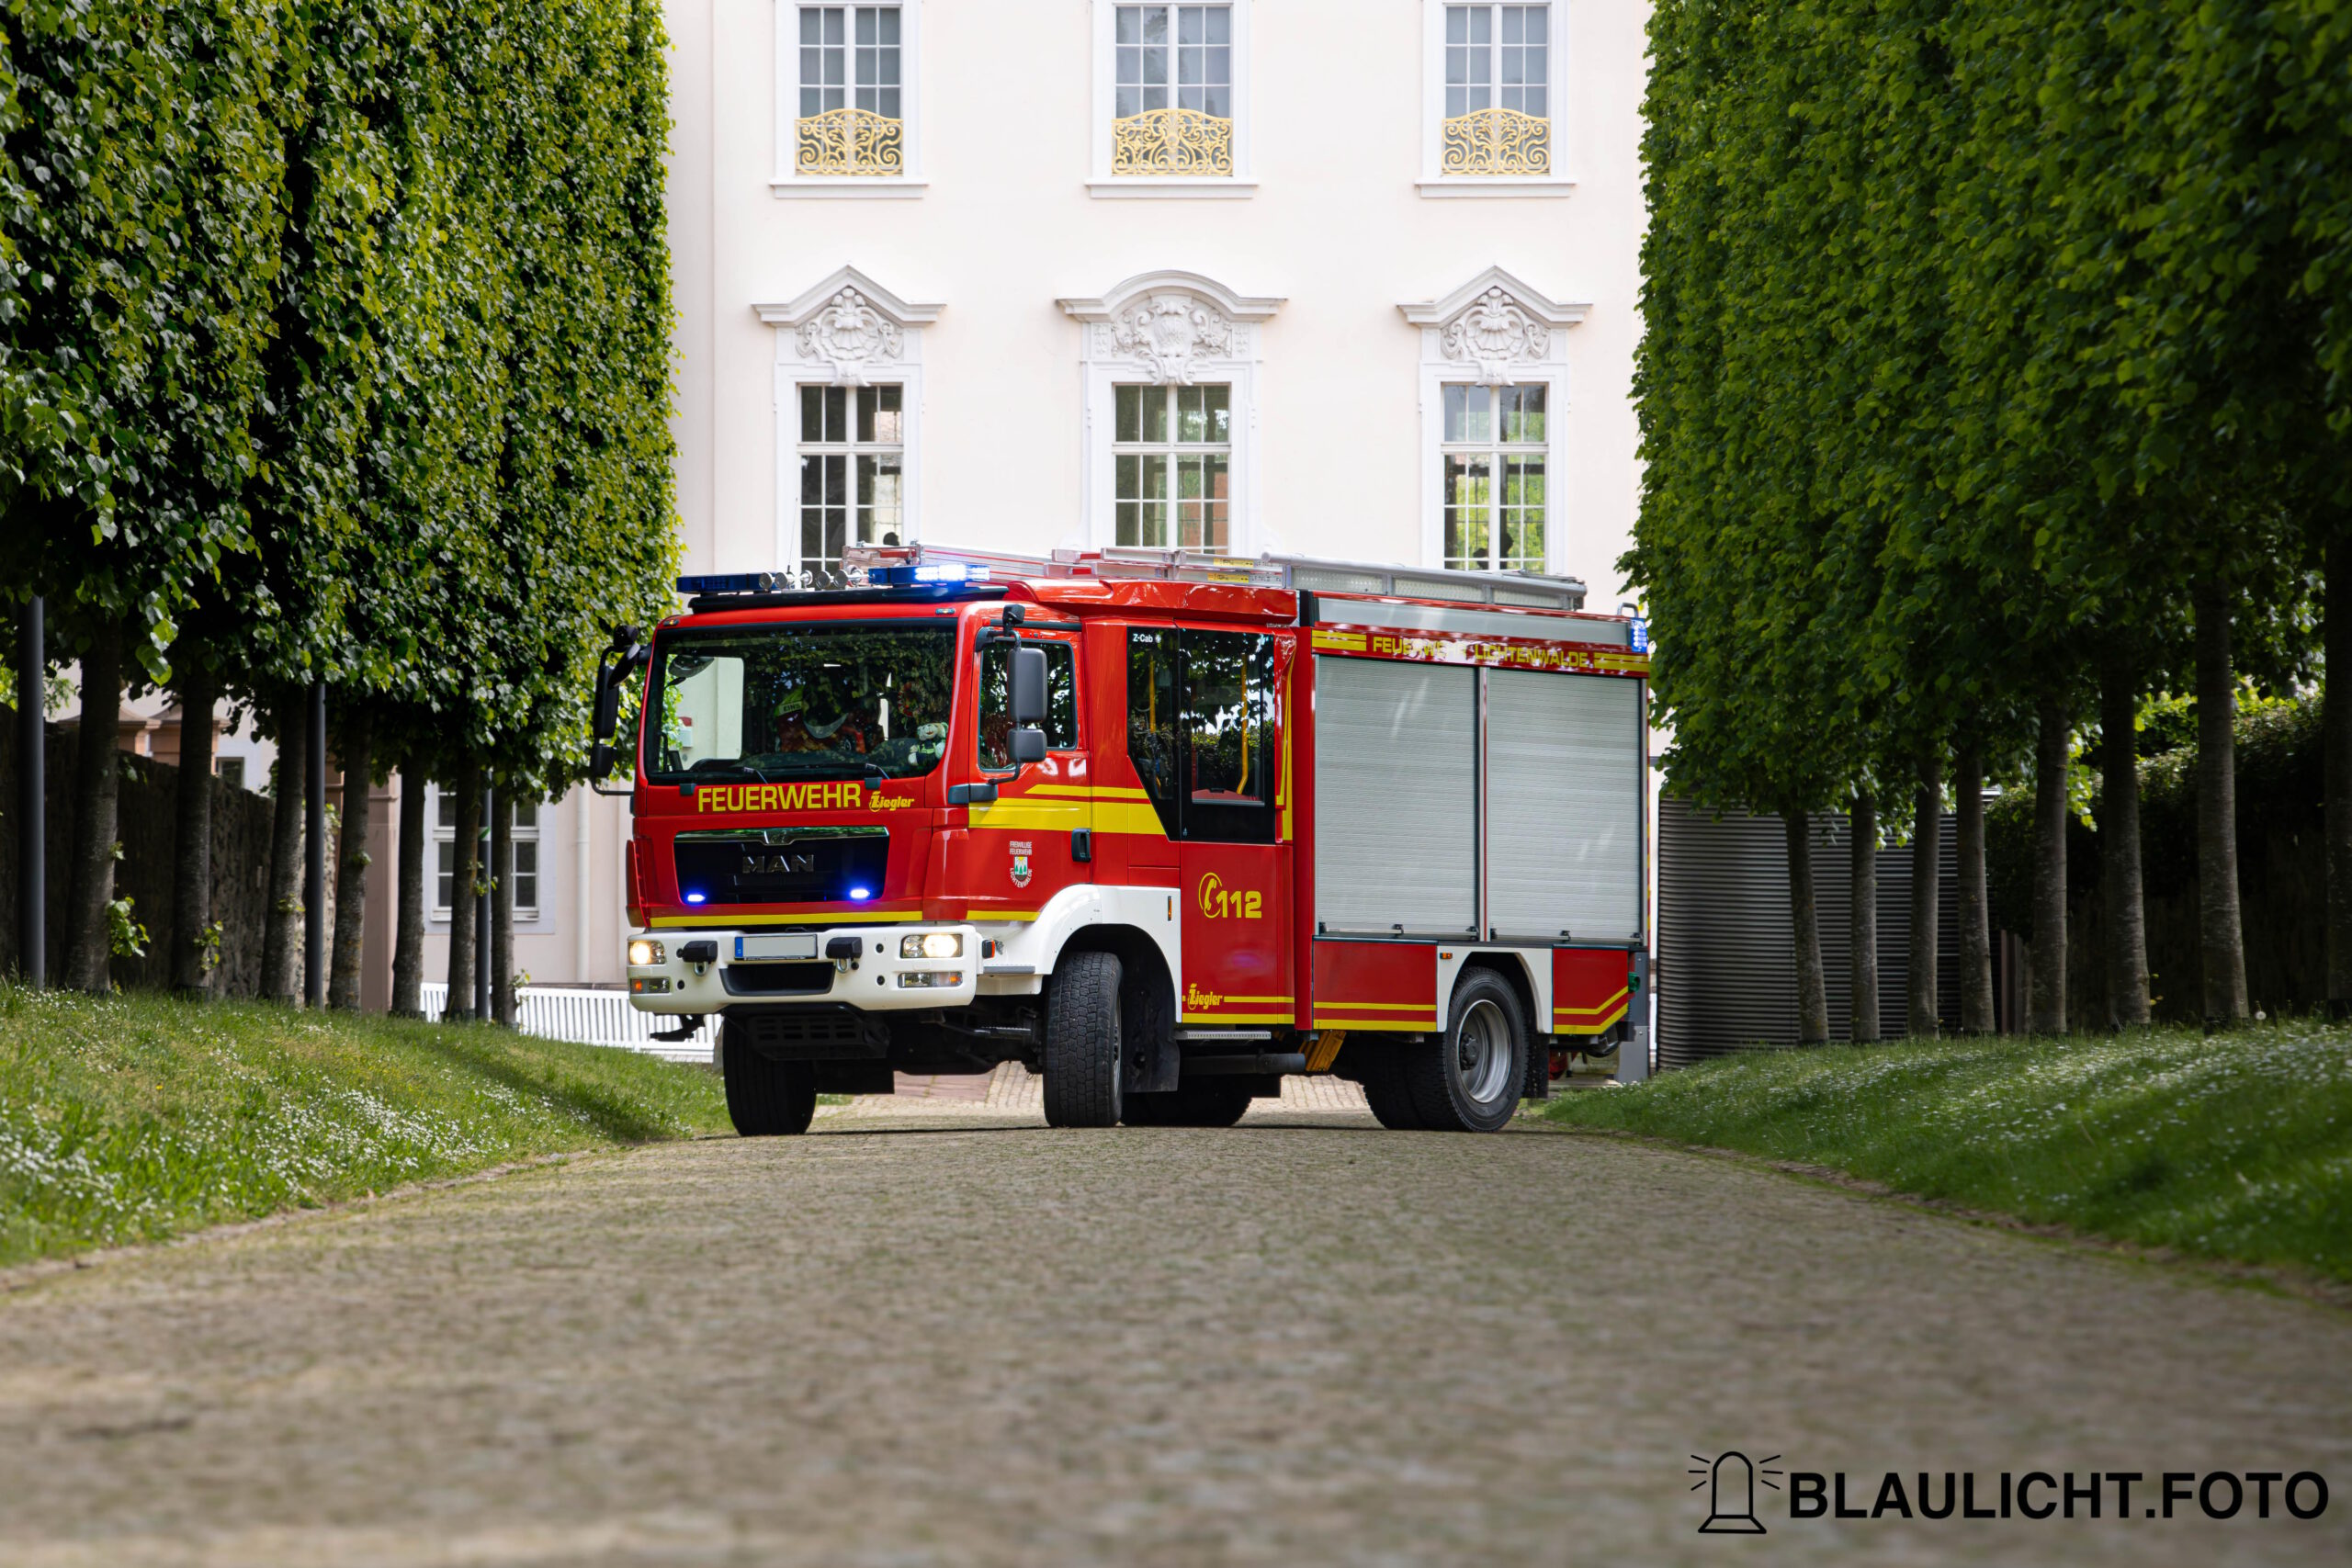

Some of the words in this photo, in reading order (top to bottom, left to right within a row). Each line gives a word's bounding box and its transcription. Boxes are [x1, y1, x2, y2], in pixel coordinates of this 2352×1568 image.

[1133, 634, 1153, 642] Z-Cab
[1475, 644, 1589, 668] LICHTENWALDE
[698, 784, 861, 812] FEUERWEHR
[742, 854, 814, 874] MAN
[1216, 890, 1262, 919] 112
